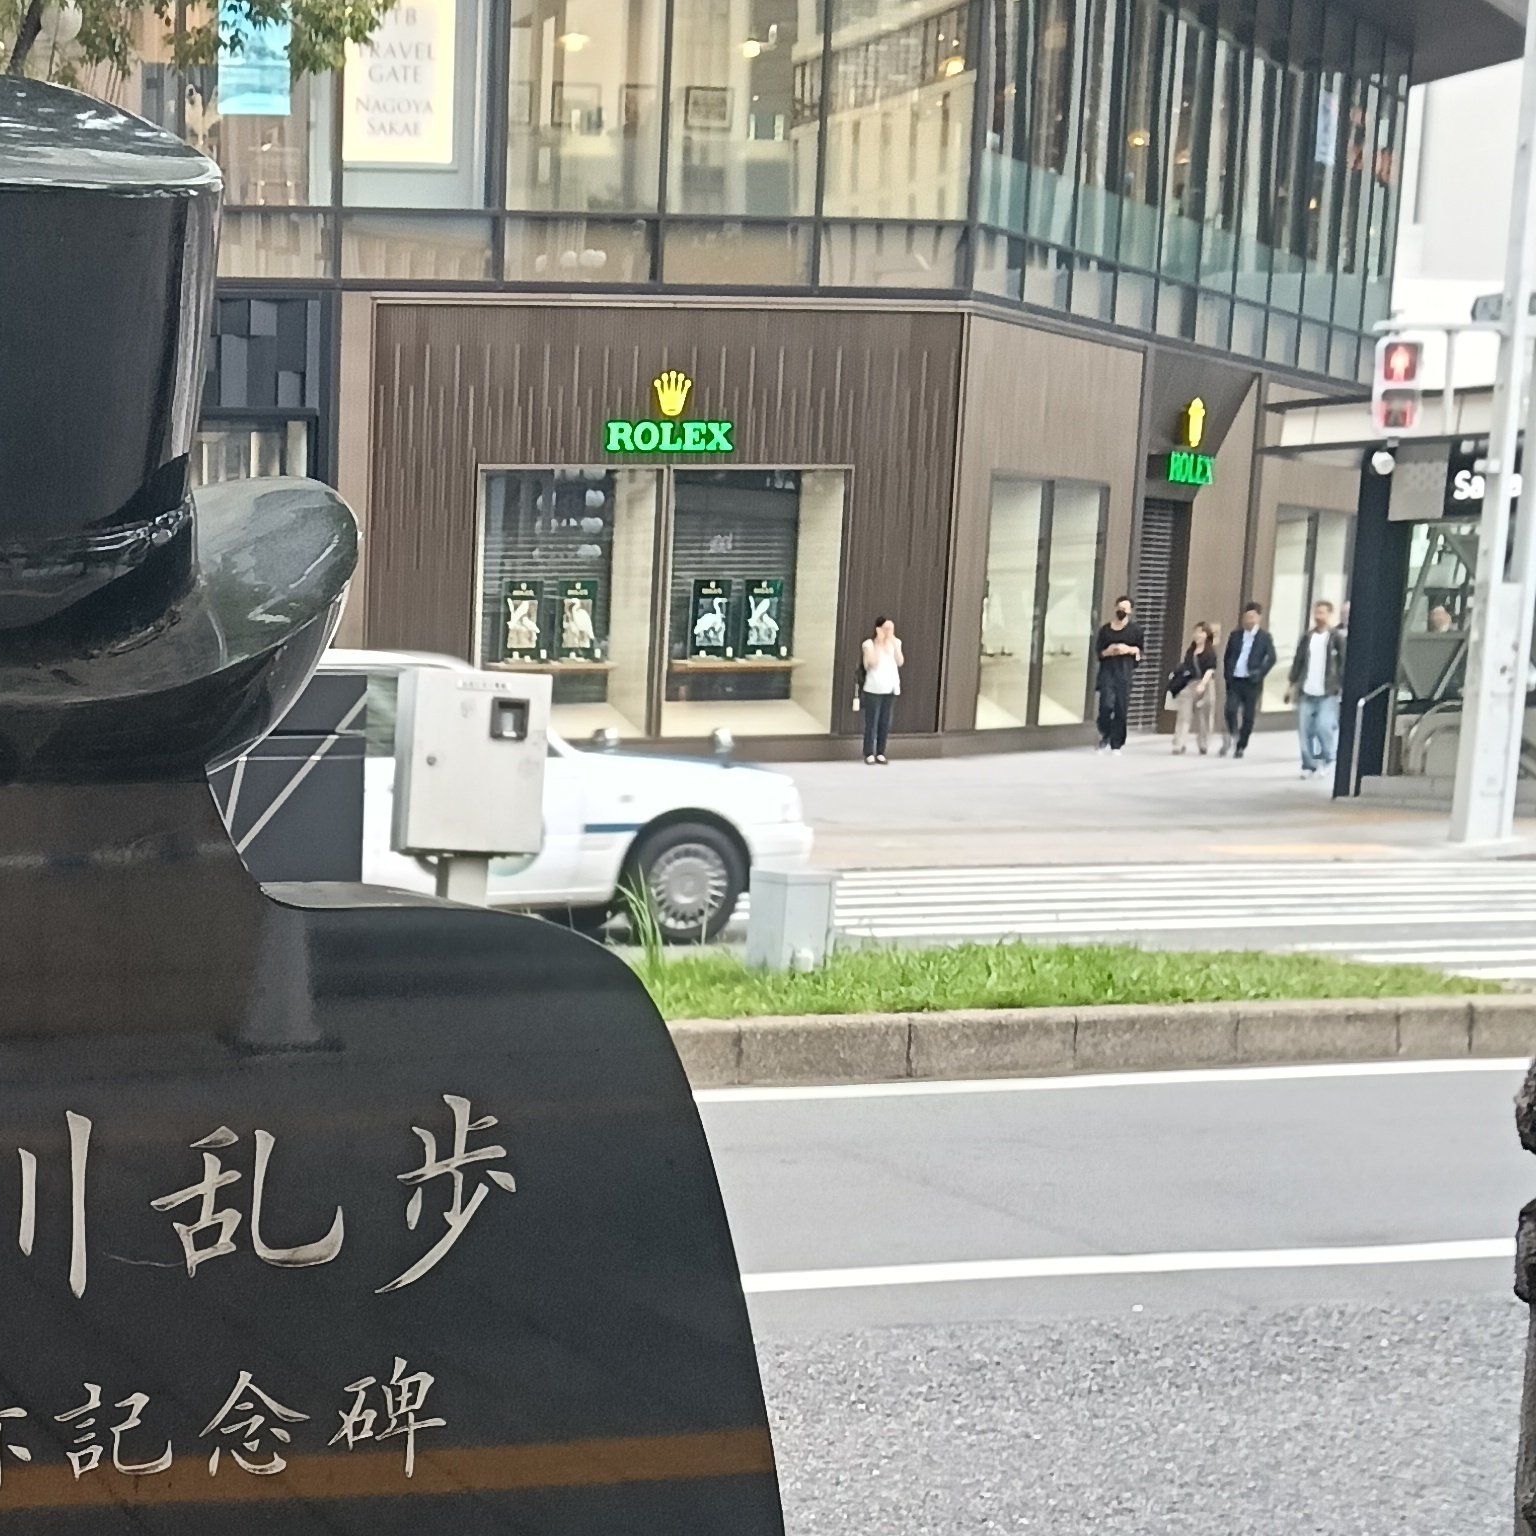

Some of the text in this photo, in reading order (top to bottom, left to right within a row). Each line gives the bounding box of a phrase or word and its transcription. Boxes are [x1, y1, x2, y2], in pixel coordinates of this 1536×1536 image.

[357, 41, 436, 61] TRAVEL
[368, 63, 423, 84] GATE
[355, 96, 434, 115] NAGOYA
[366, 117, 422, 137] SAKAE
[606, 421, 734, 452] ROLEX
[1168, 451, 1215, 485] ROLEX
